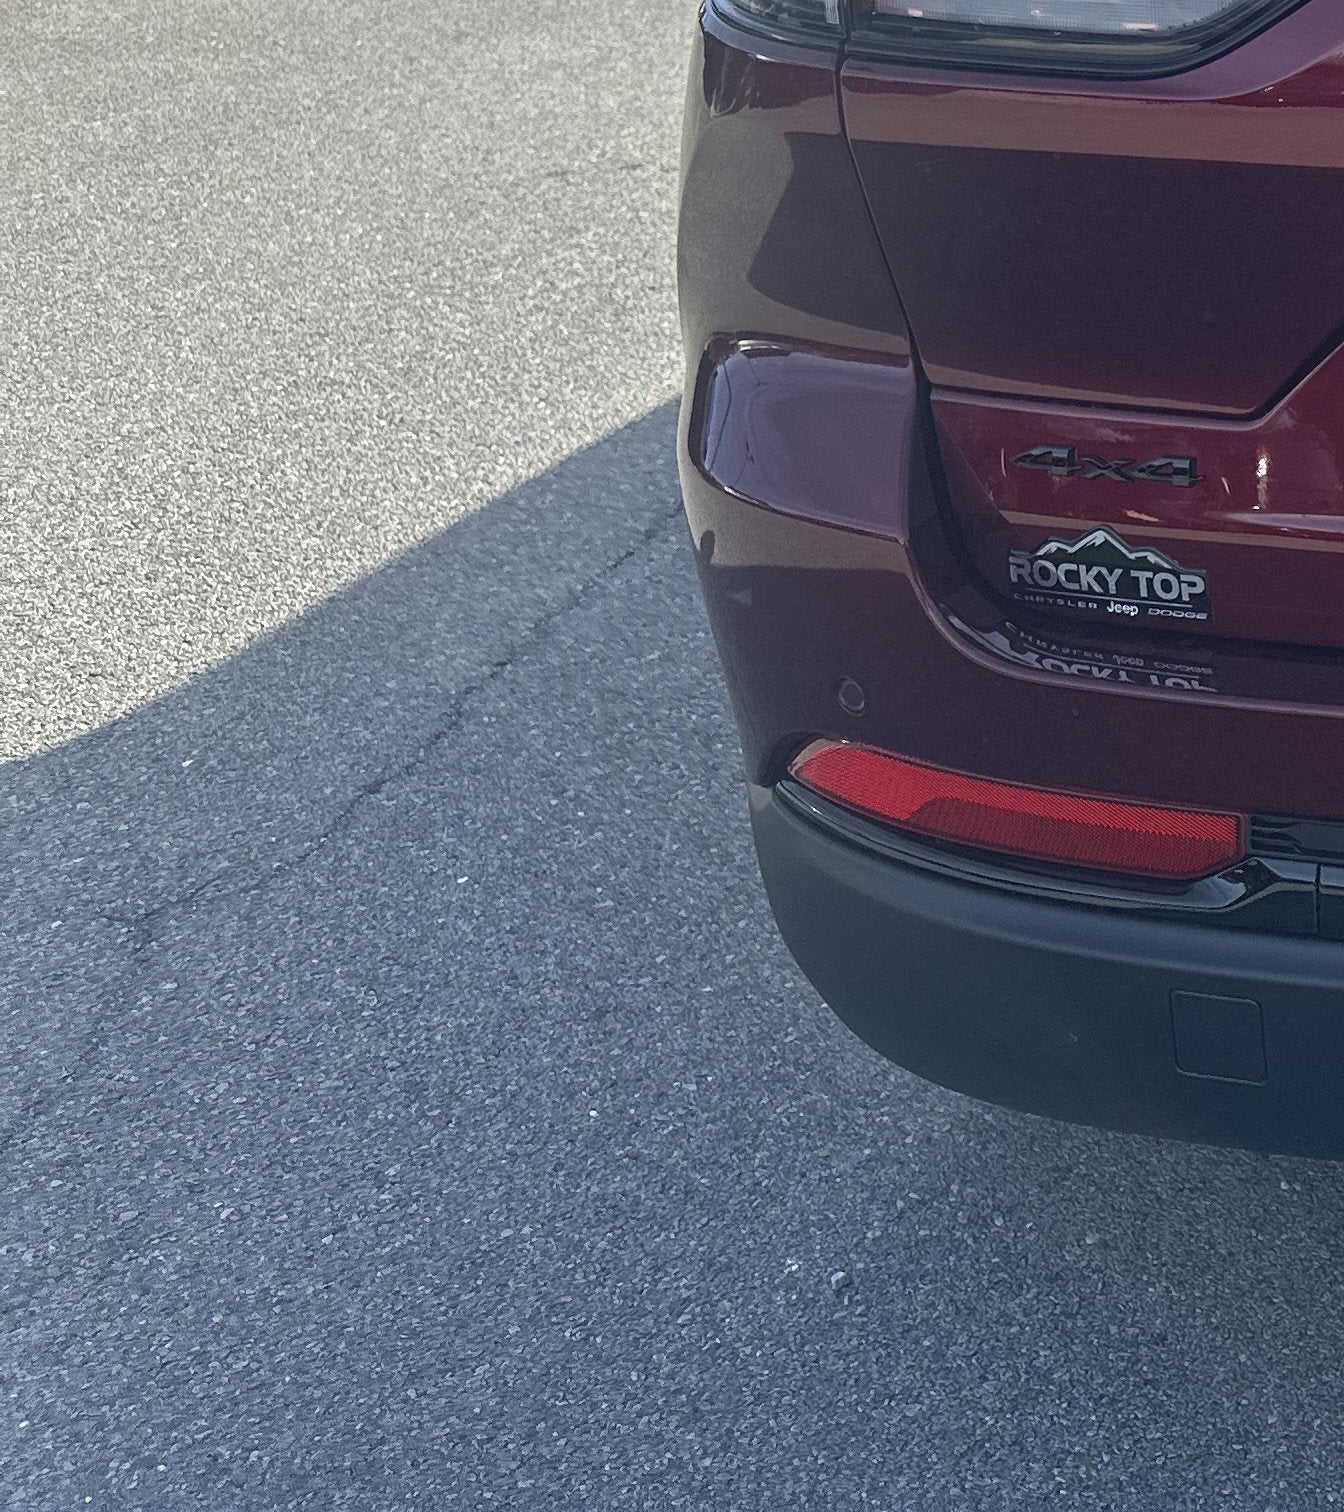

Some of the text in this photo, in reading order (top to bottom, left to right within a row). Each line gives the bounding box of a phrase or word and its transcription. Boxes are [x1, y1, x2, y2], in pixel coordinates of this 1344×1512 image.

[1008, 555, 1206, 602] ROCKY TOP
[1013, 592, 1209, 620] CHRYSLER Jeep DODGE
